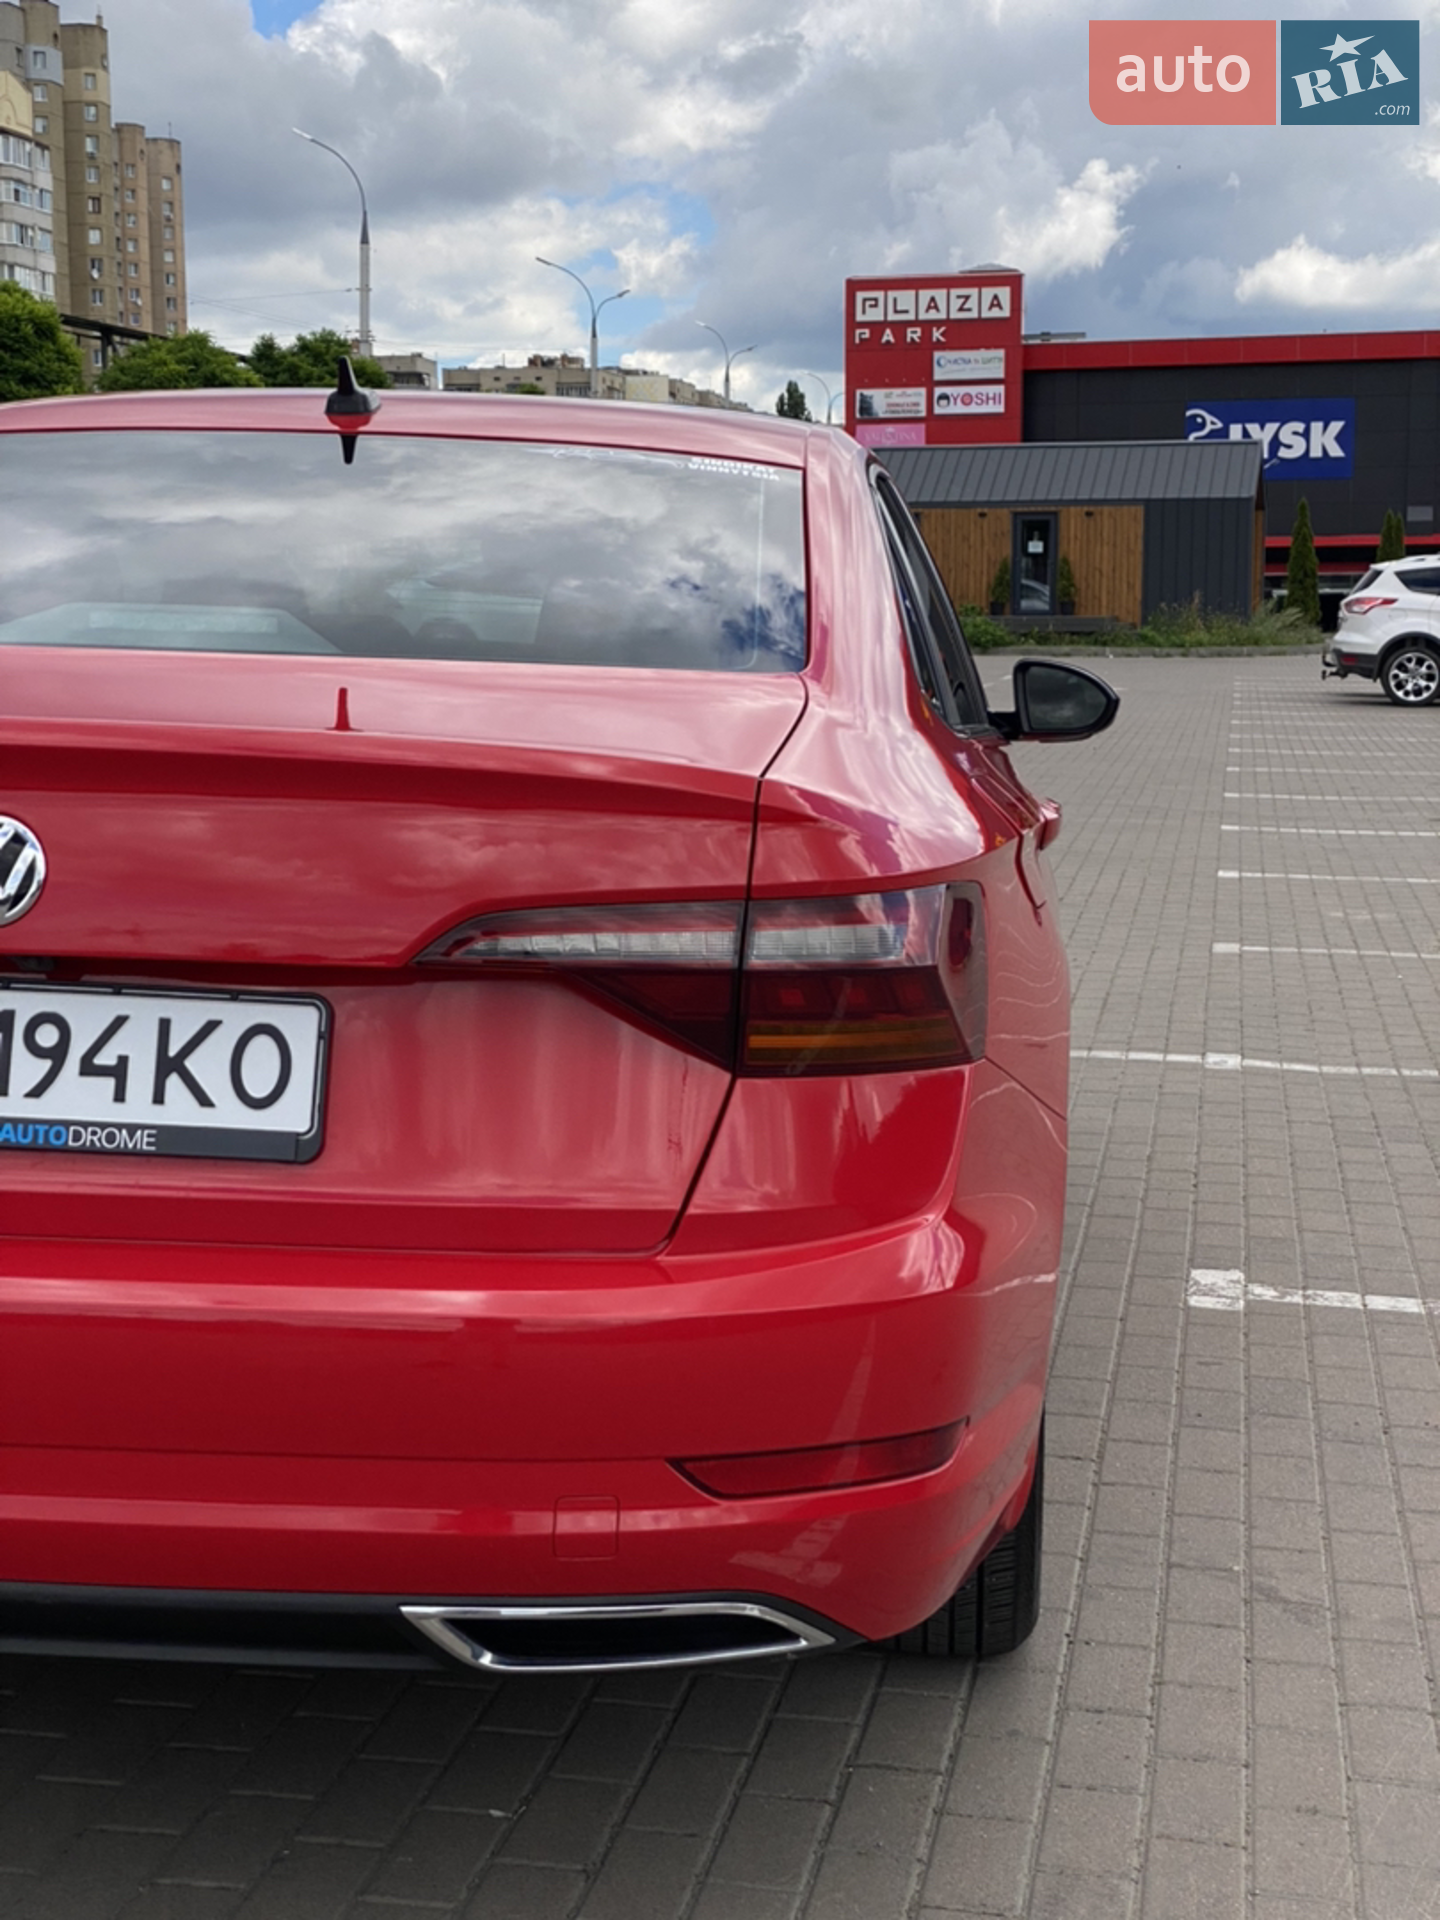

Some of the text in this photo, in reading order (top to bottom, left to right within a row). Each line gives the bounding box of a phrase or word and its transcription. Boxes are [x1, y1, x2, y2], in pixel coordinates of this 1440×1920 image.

[860, 293, 1004, 316] PLAZA
[855, 327, 946, 344] PARK
[950, 392, 1002, 407] YOSHI
[0, 1122, 158, 1150] AUTODROME
